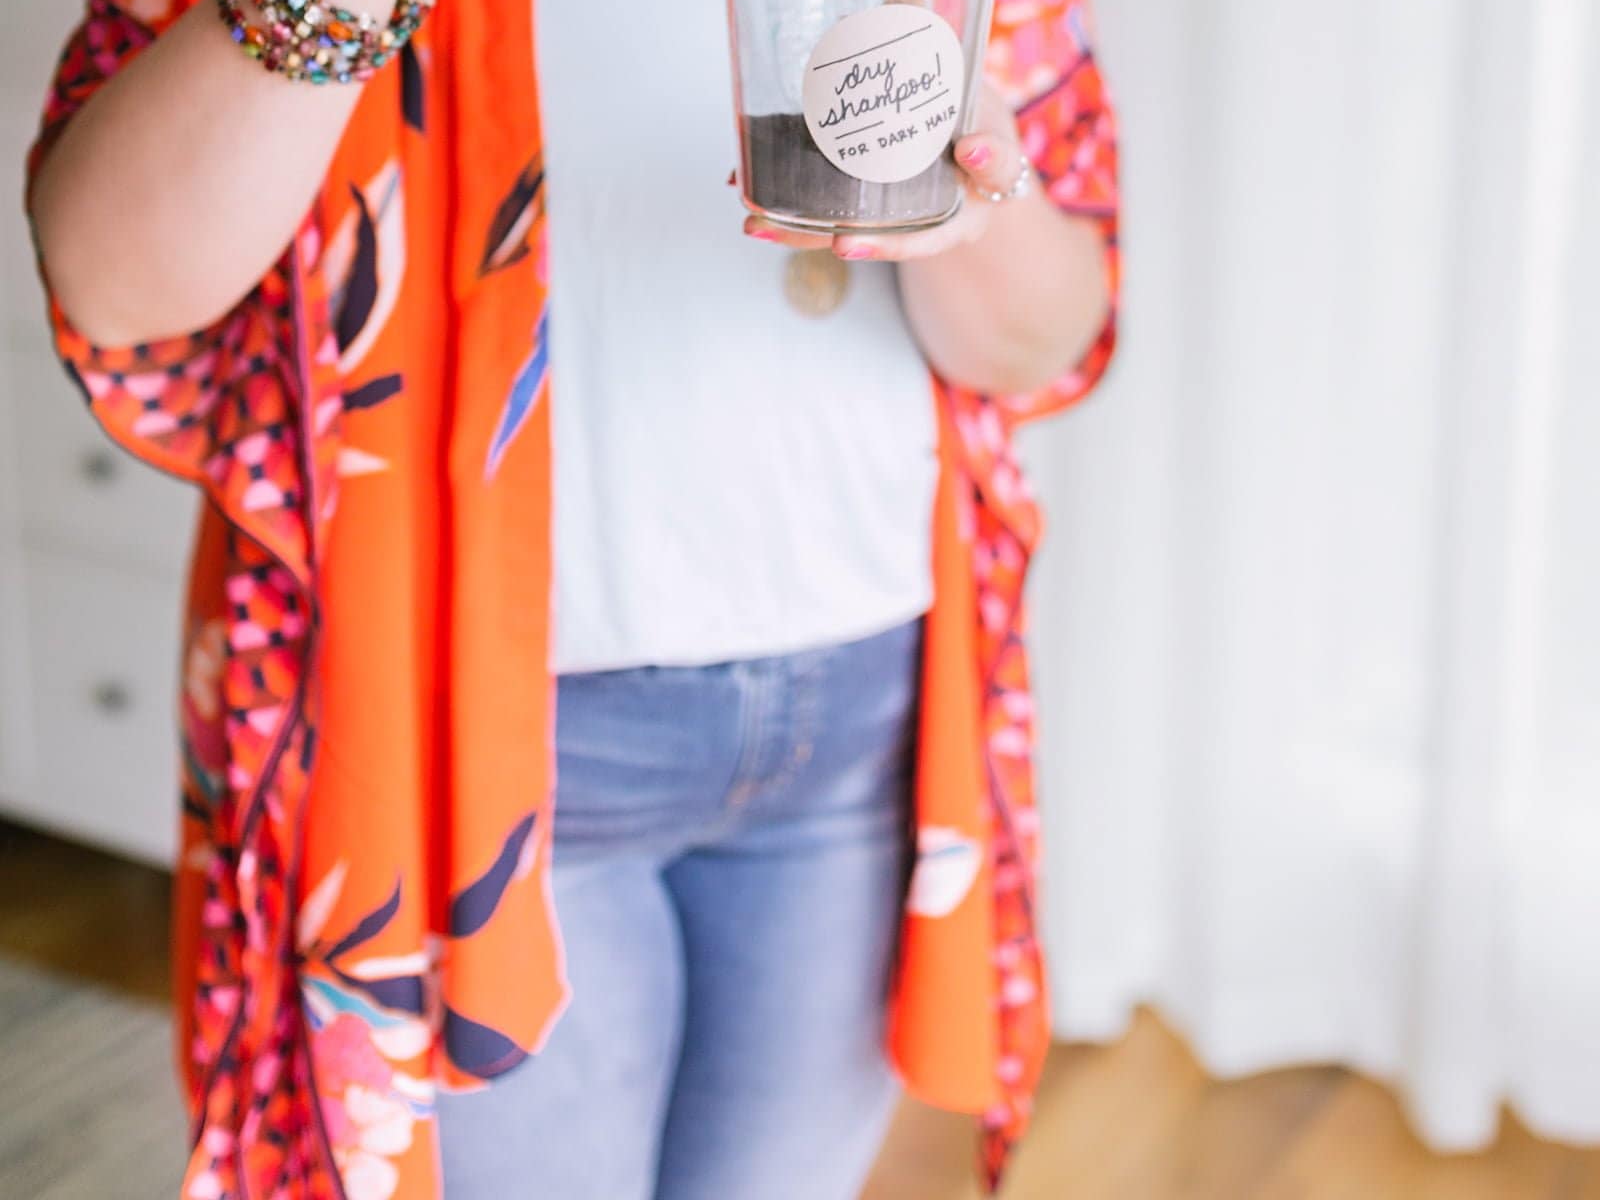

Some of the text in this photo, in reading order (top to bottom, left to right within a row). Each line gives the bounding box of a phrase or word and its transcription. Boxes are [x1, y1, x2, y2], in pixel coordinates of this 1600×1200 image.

[818, 53, 943, 128] shampoo!
[835, 58, 896, 95] dry
[838, 105, 957, 160] FOR DARK HAIR
